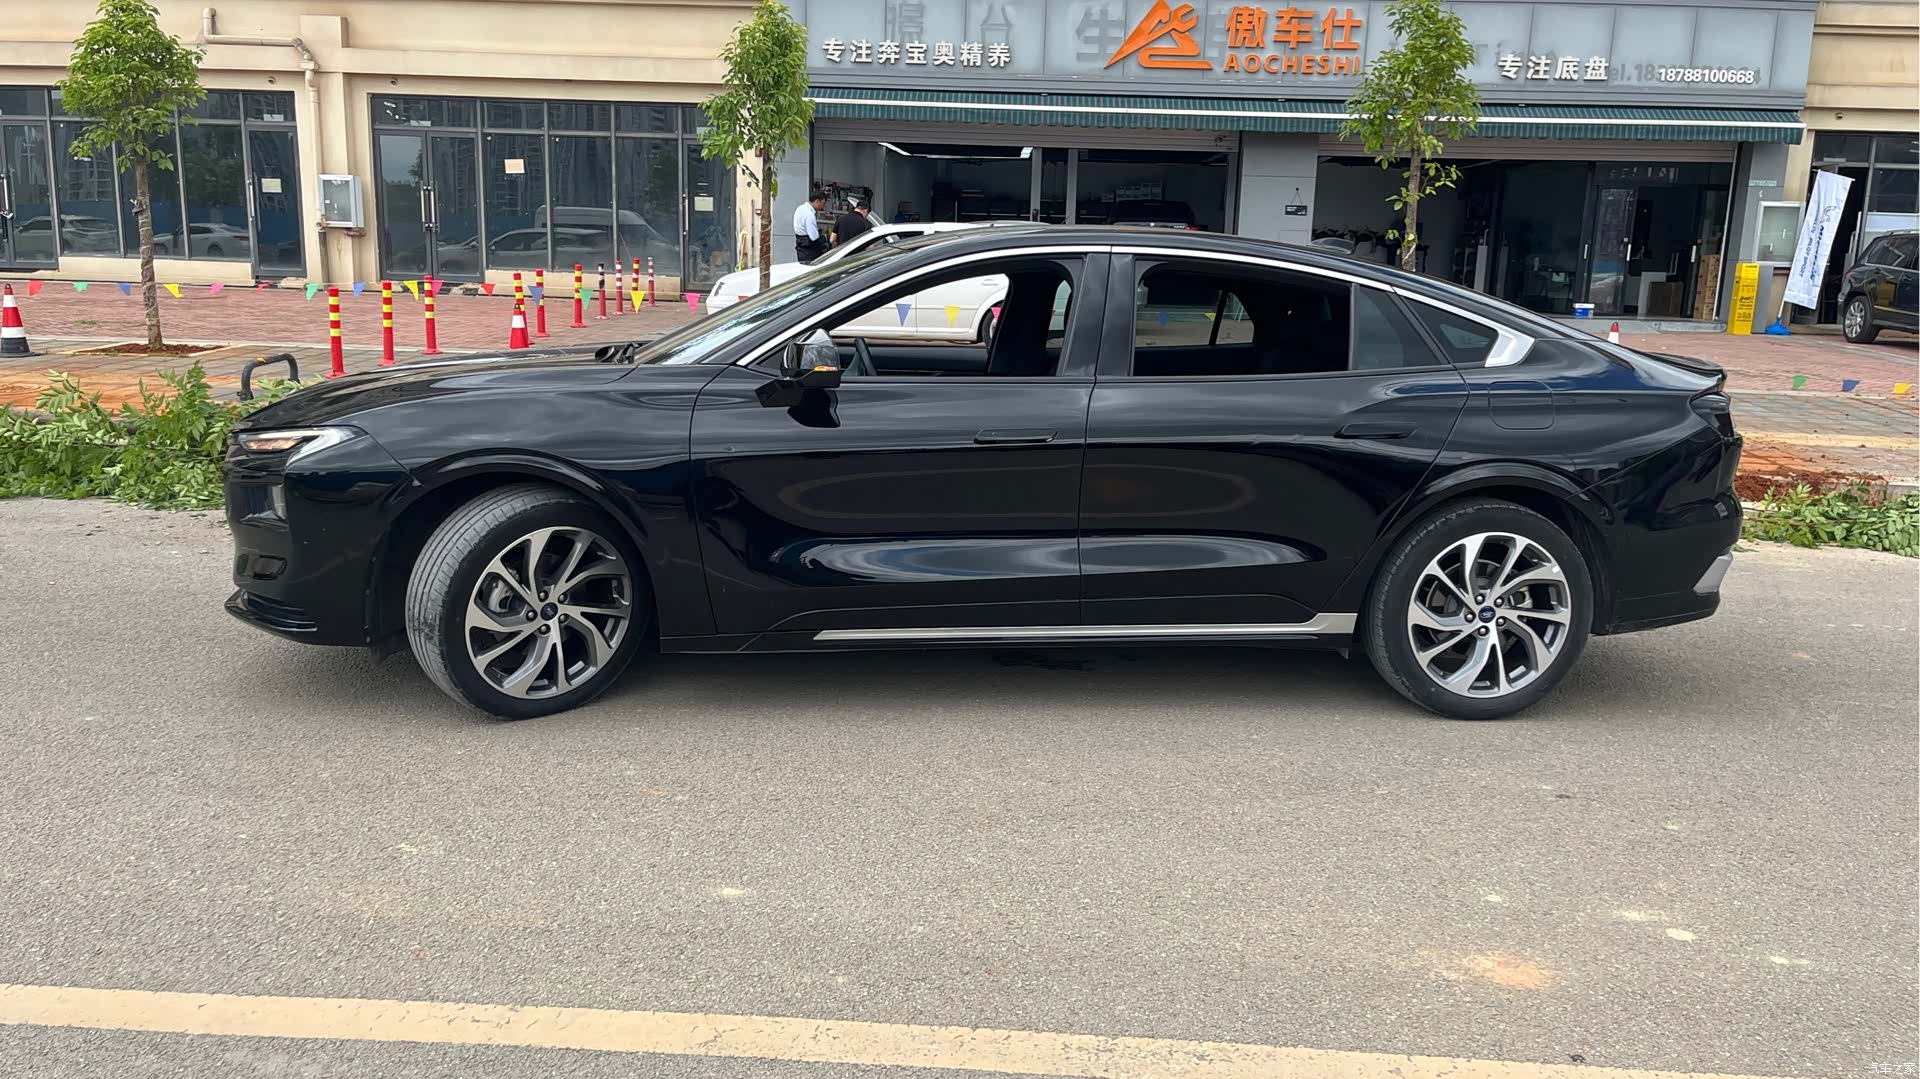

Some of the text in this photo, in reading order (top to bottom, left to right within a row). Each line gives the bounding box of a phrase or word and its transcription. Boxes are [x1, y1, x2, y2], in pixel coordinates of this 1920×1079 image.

[1226, 5, 1363, 50] 傲车仕
[822, 39, 1012, 69] 专注奔宝奥精养
[1224, 53, 1361, 75] AOCHESHI
[1498, 54, 1610, 81] 专注底盘
[1658, 68, 1755, 84] 18788100668
